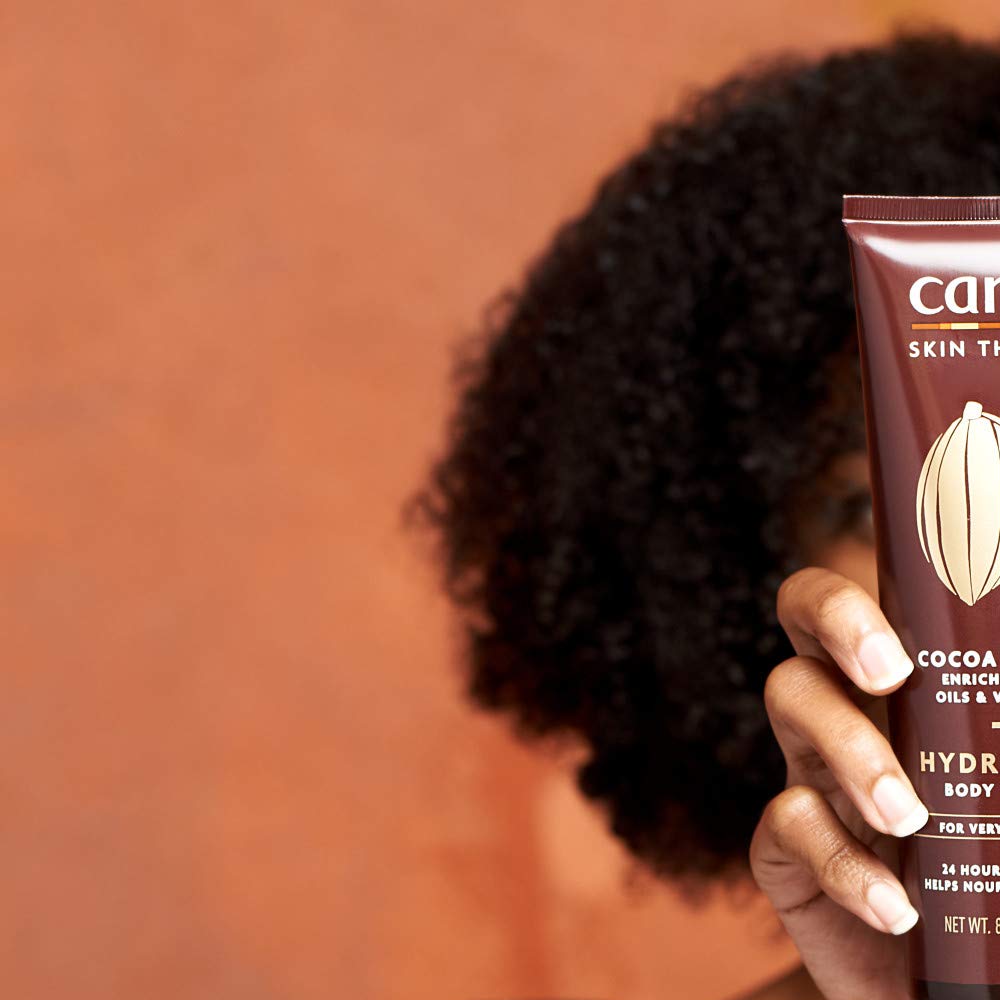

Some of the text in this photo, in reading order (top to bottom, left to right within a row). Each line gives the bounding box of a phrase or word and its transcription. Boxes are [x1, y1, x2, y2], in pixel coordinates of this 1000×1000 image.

[909, 340, 966, 358] SKIN
[917, 649, 998, 669] COCOA
[935, 690, 970, 704] OILS
[975, 690, 988, 704] &
[944, 782, 995, 798] BODY
[939, 821, 965, 834] FOR
[941, 863, 956, 876] 24
[960, 863, 1000, 877] HOUR
[924, 878, 959, 892] HELPS
[944, 915, 965, 934] NET
[968, 916, 991, 935] WT.
